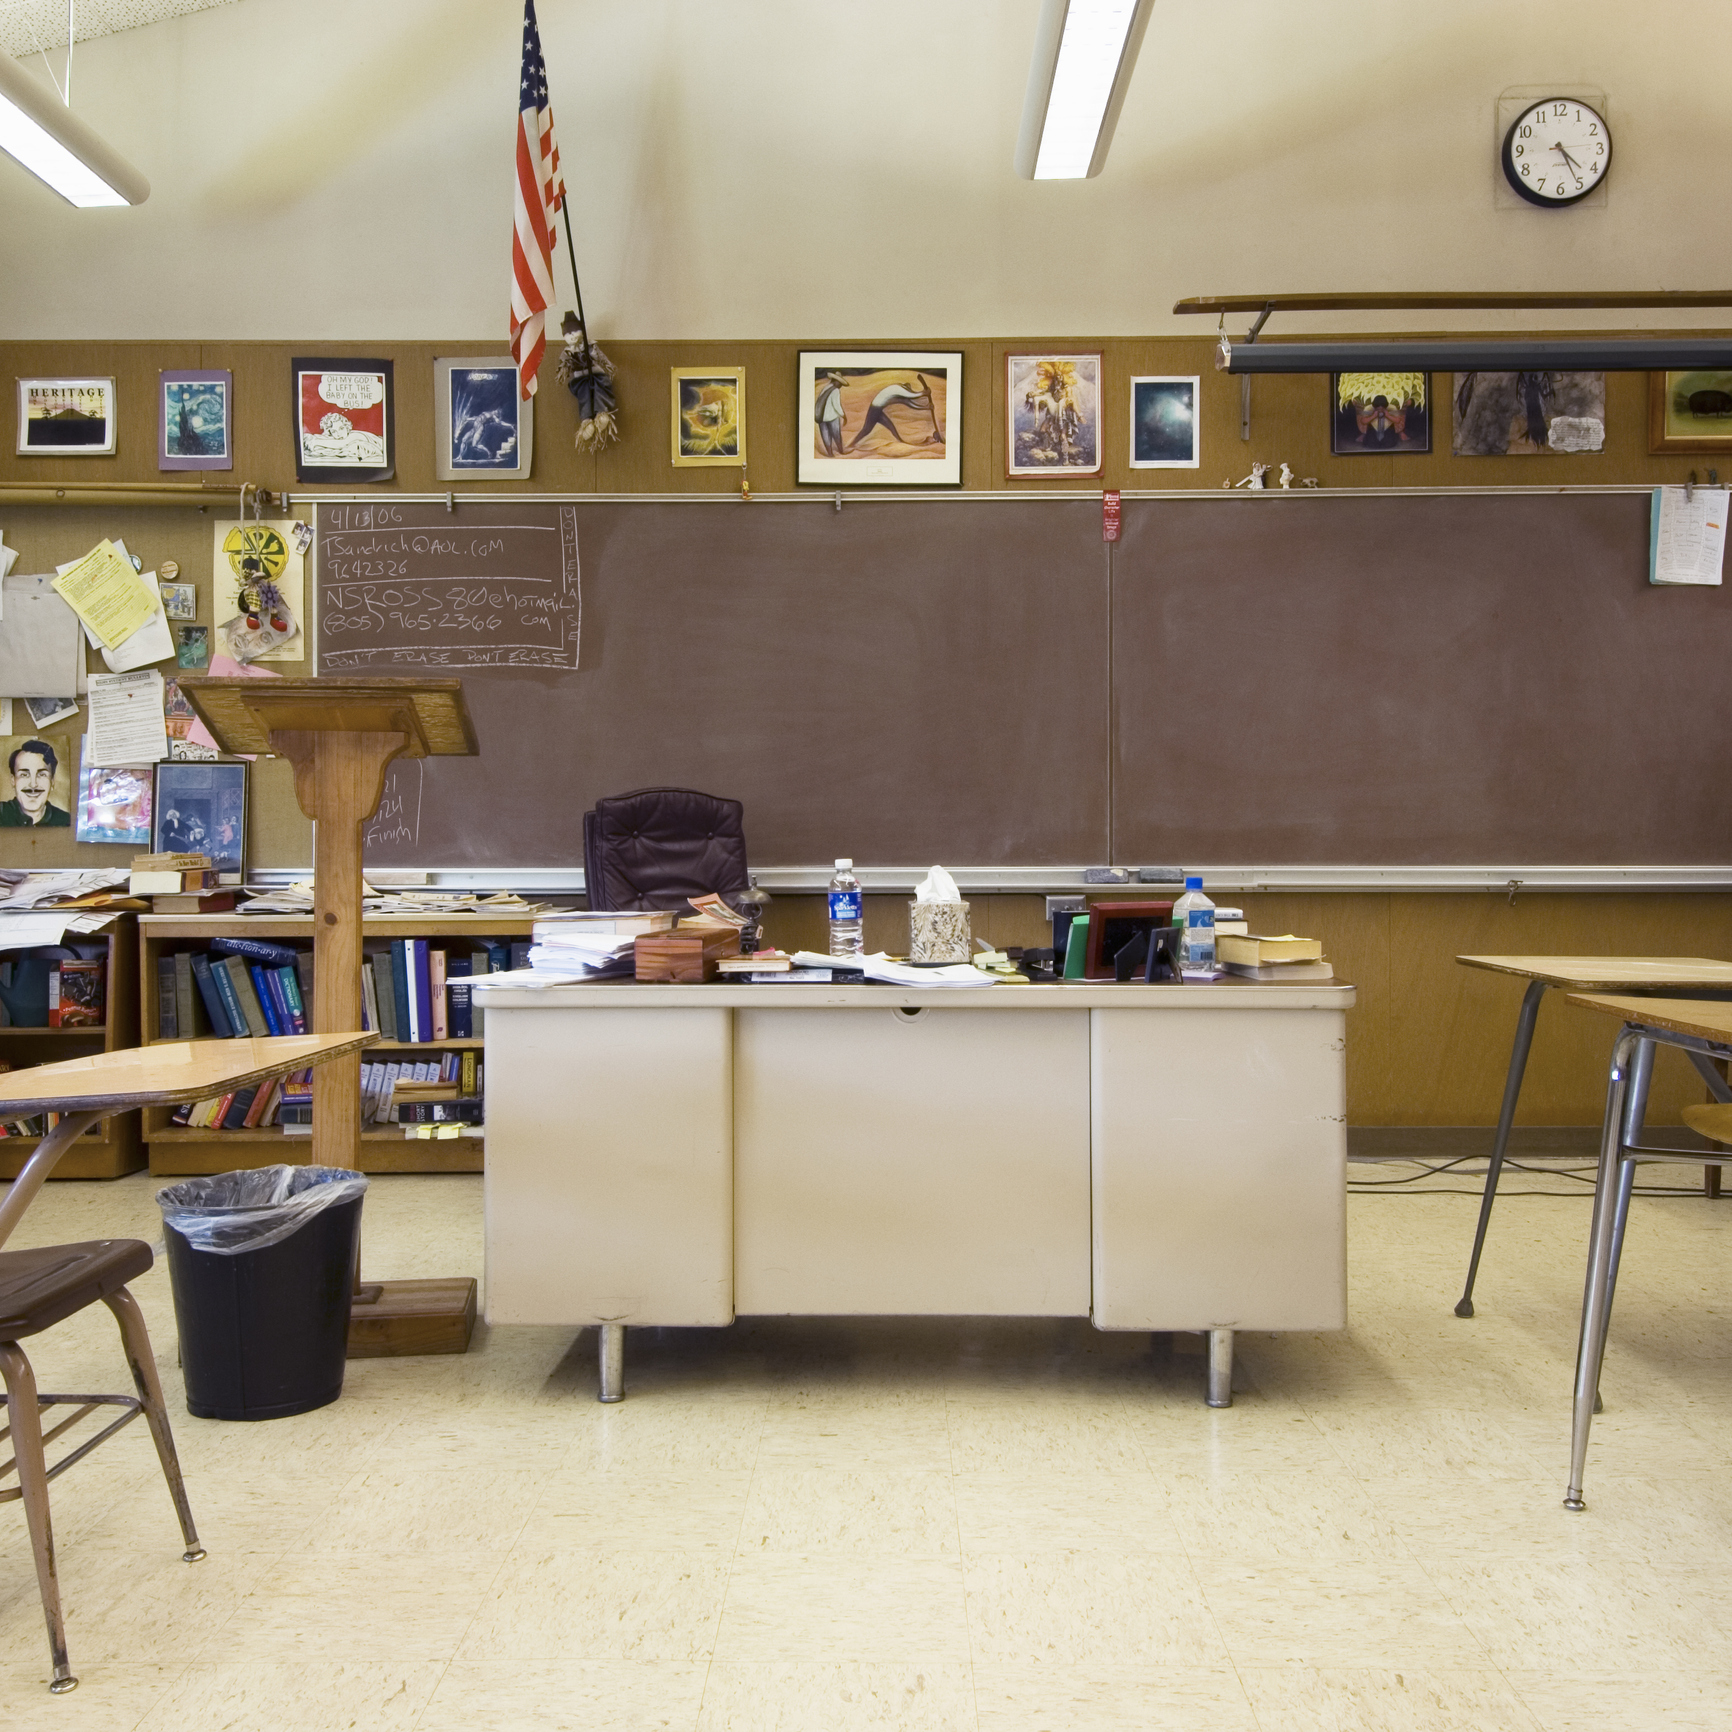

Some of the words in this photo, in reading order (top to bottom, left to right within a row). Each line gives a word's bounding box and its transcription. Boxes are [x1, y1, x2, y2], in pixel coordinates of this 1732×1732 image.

[1536, 110, 1546, 123] 11
[1553, 104, 1568, 116] 12
[1576, 110, 1581, 122] 1
[1519, 125, 1532, 138] 10
[1589, 123, 1598, 136] 2
[1516, 144, 1524, 158] 9
[1596, 142, 1604, 155] 3
[1521, 163, 1530, 176] 8
[1590, 162, 1598, 174] 4
[1537, 178, 1546, 191] 7
[1556, 182, 1565, 195] 6
[1575, 177, 1584, 190] 5
[30, 388, 105, 397] HERITAGE
[328, 560, 408, 579] 9642326
[323, 611, 384, 635] (805)
[324, 651, 377, 667] DON'T
[392, 651, 451, 664] ERASE
[508, 649, 570, 664] ERASE
[284, 978, 295, 1006] DICTIONARY
